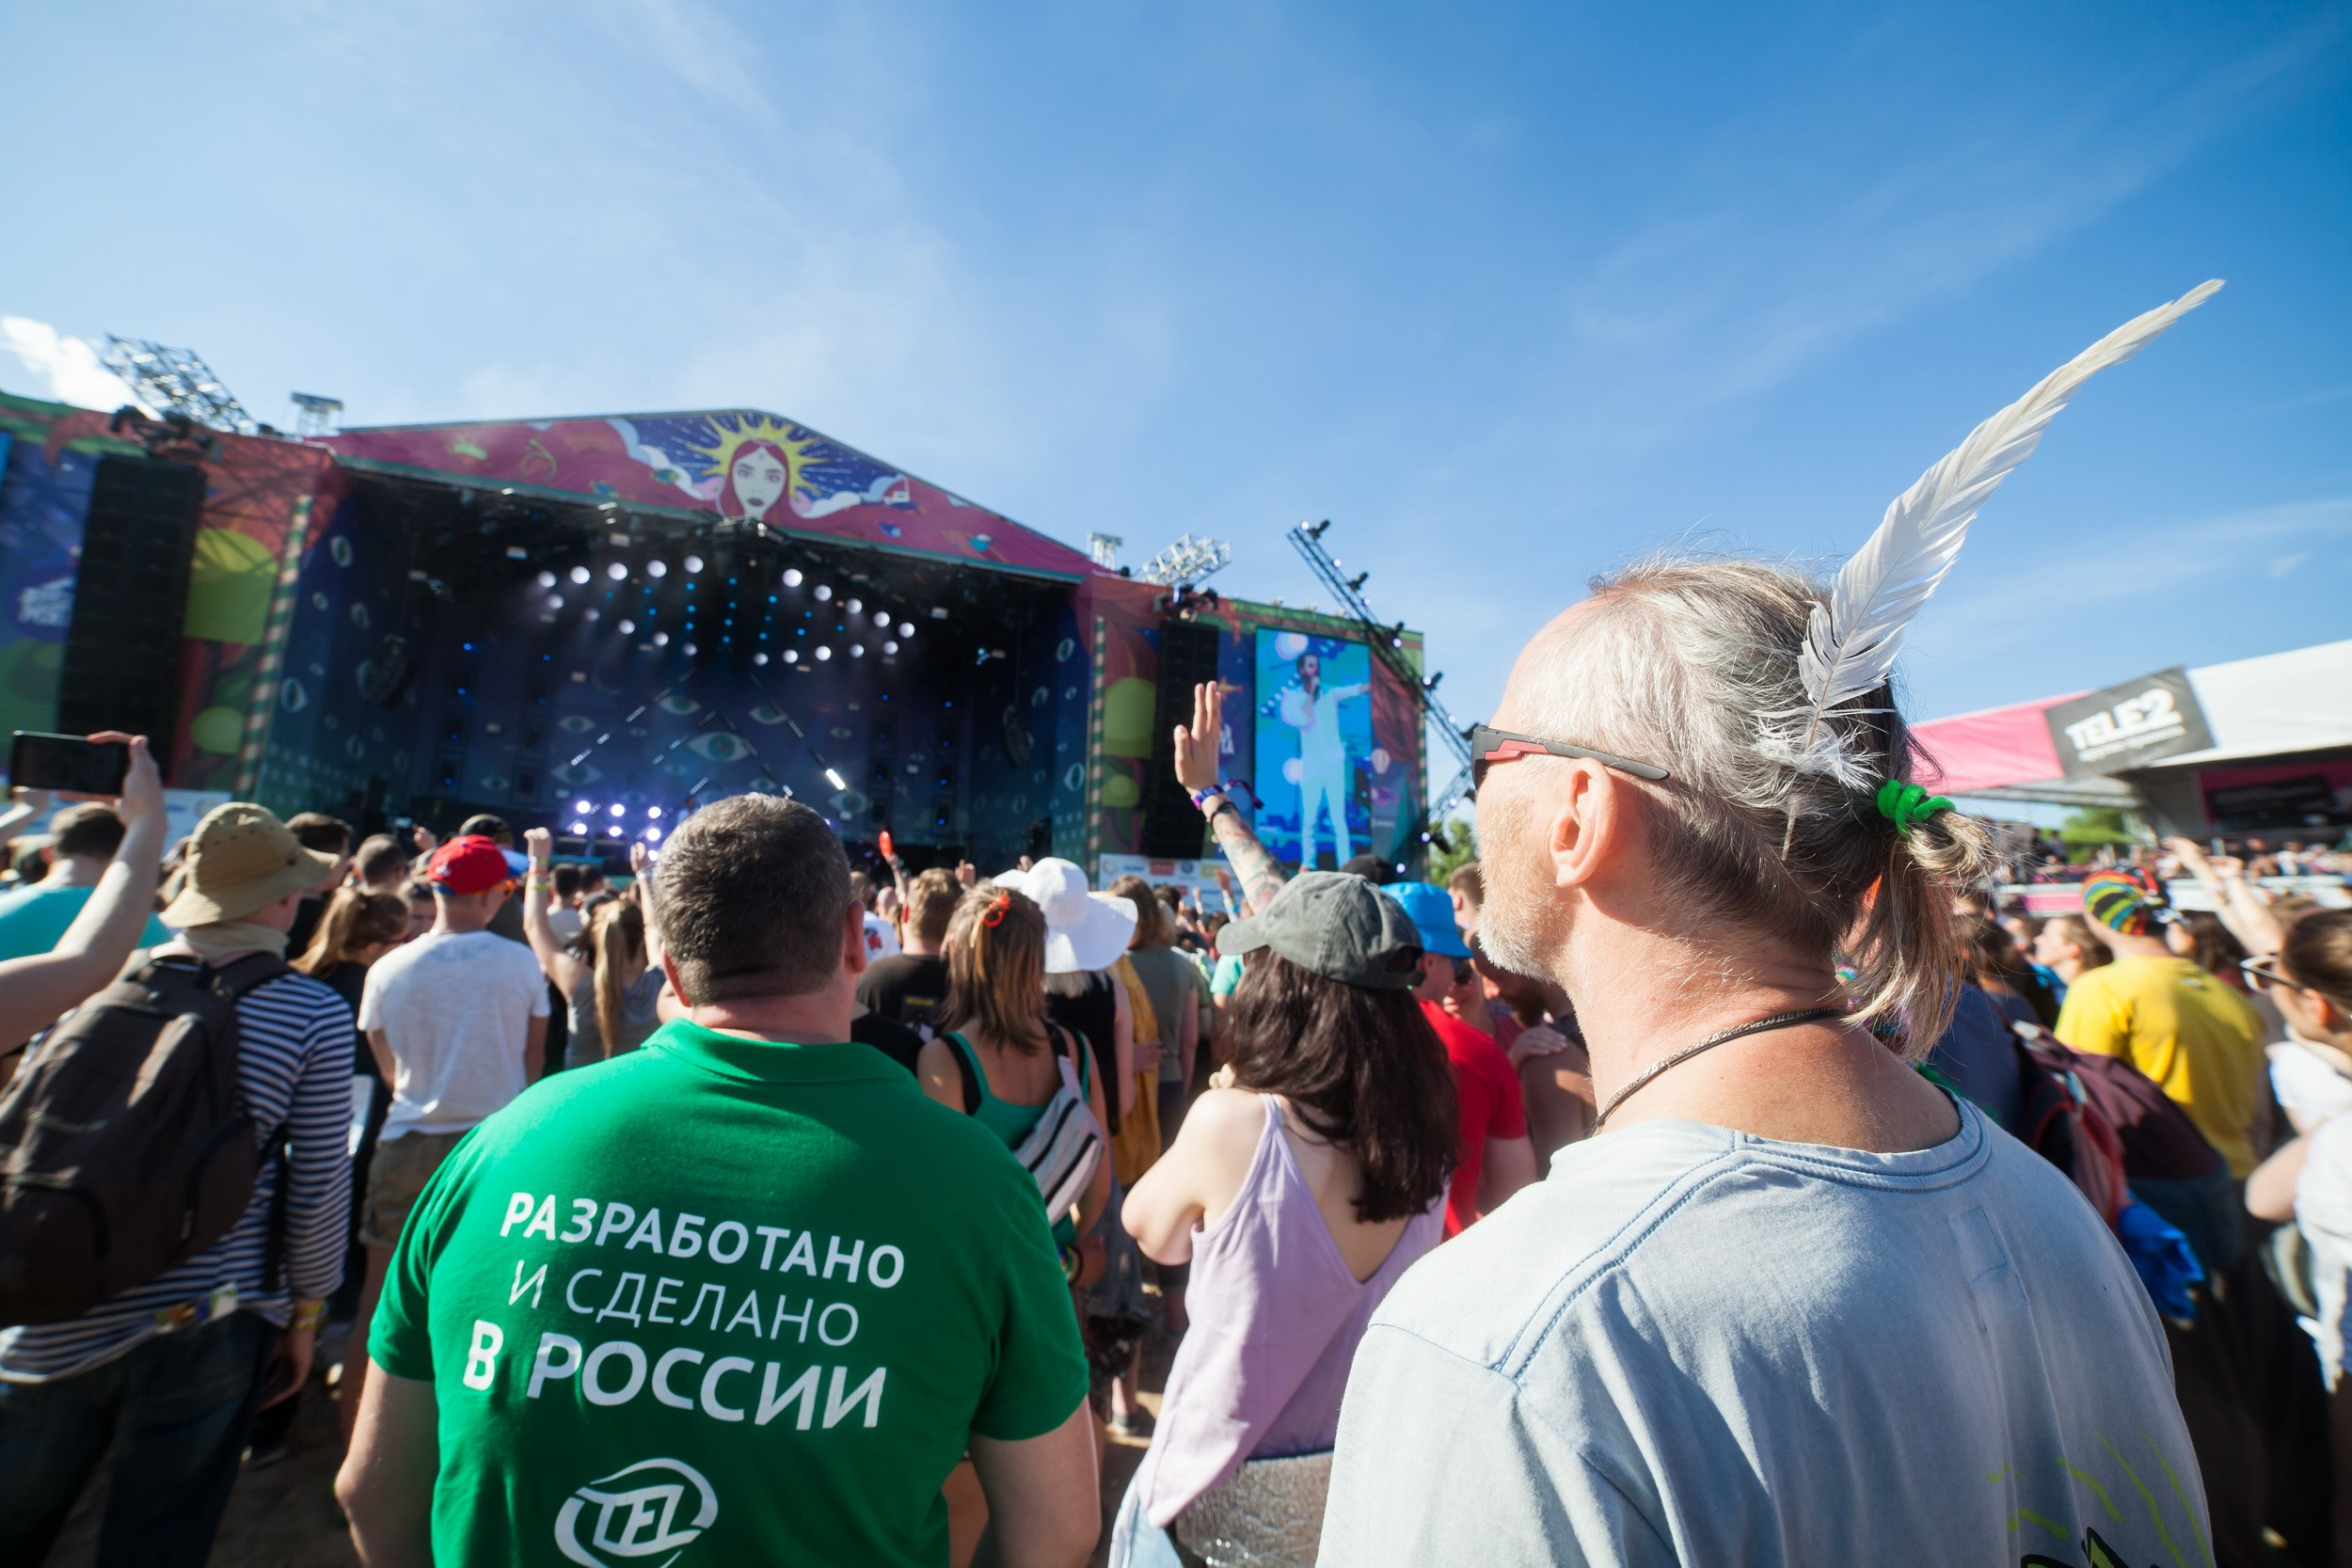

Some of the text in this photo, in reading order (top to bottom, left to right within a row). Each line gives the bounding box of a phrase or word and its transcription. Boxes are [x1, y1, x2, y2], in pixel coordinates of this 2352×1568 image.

[2064, 688, 2183, 751] TELE2
[500, 1192, 904, 1289] РАЗРАБОТАНО
[508, 1259, 859, 1346] И СДЕЛАНО
[462, 1319, 886, 1431] В РОССИИ
